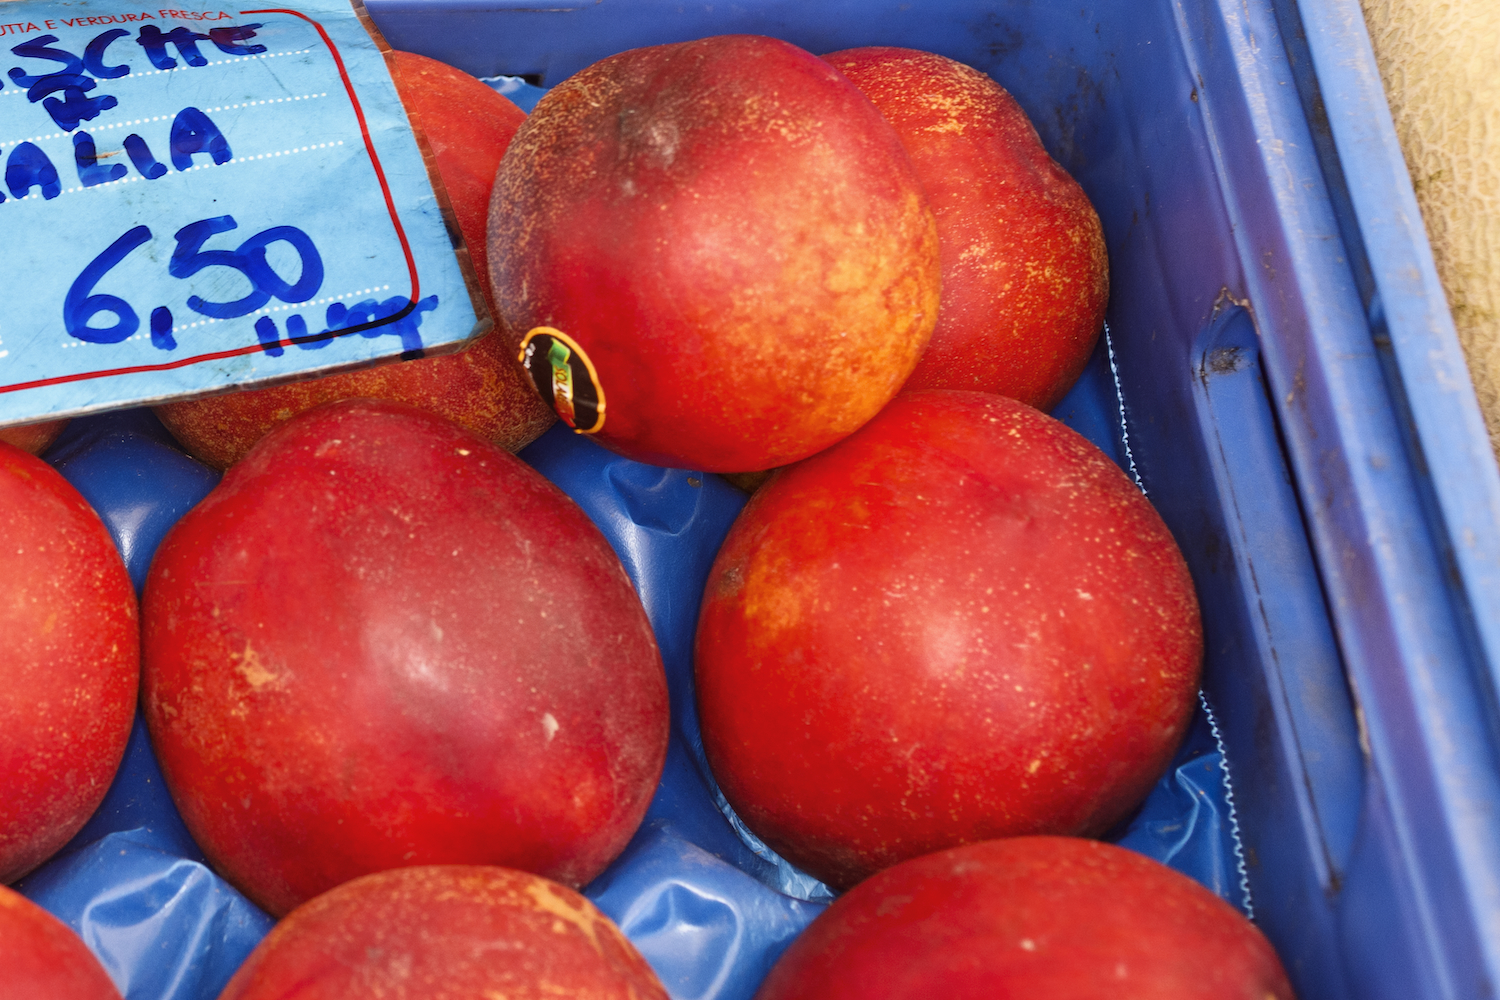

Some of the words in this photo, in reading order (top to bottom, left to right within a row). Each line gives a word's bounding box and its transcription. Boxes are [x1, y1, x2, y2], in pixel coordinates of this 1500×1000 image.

[46, 18, 59, 30] E
[60, 11, 156, 28] VERDURA
[158, 8, 234, 21] FRESCA
[63, 214, 325, 352] 6,50
